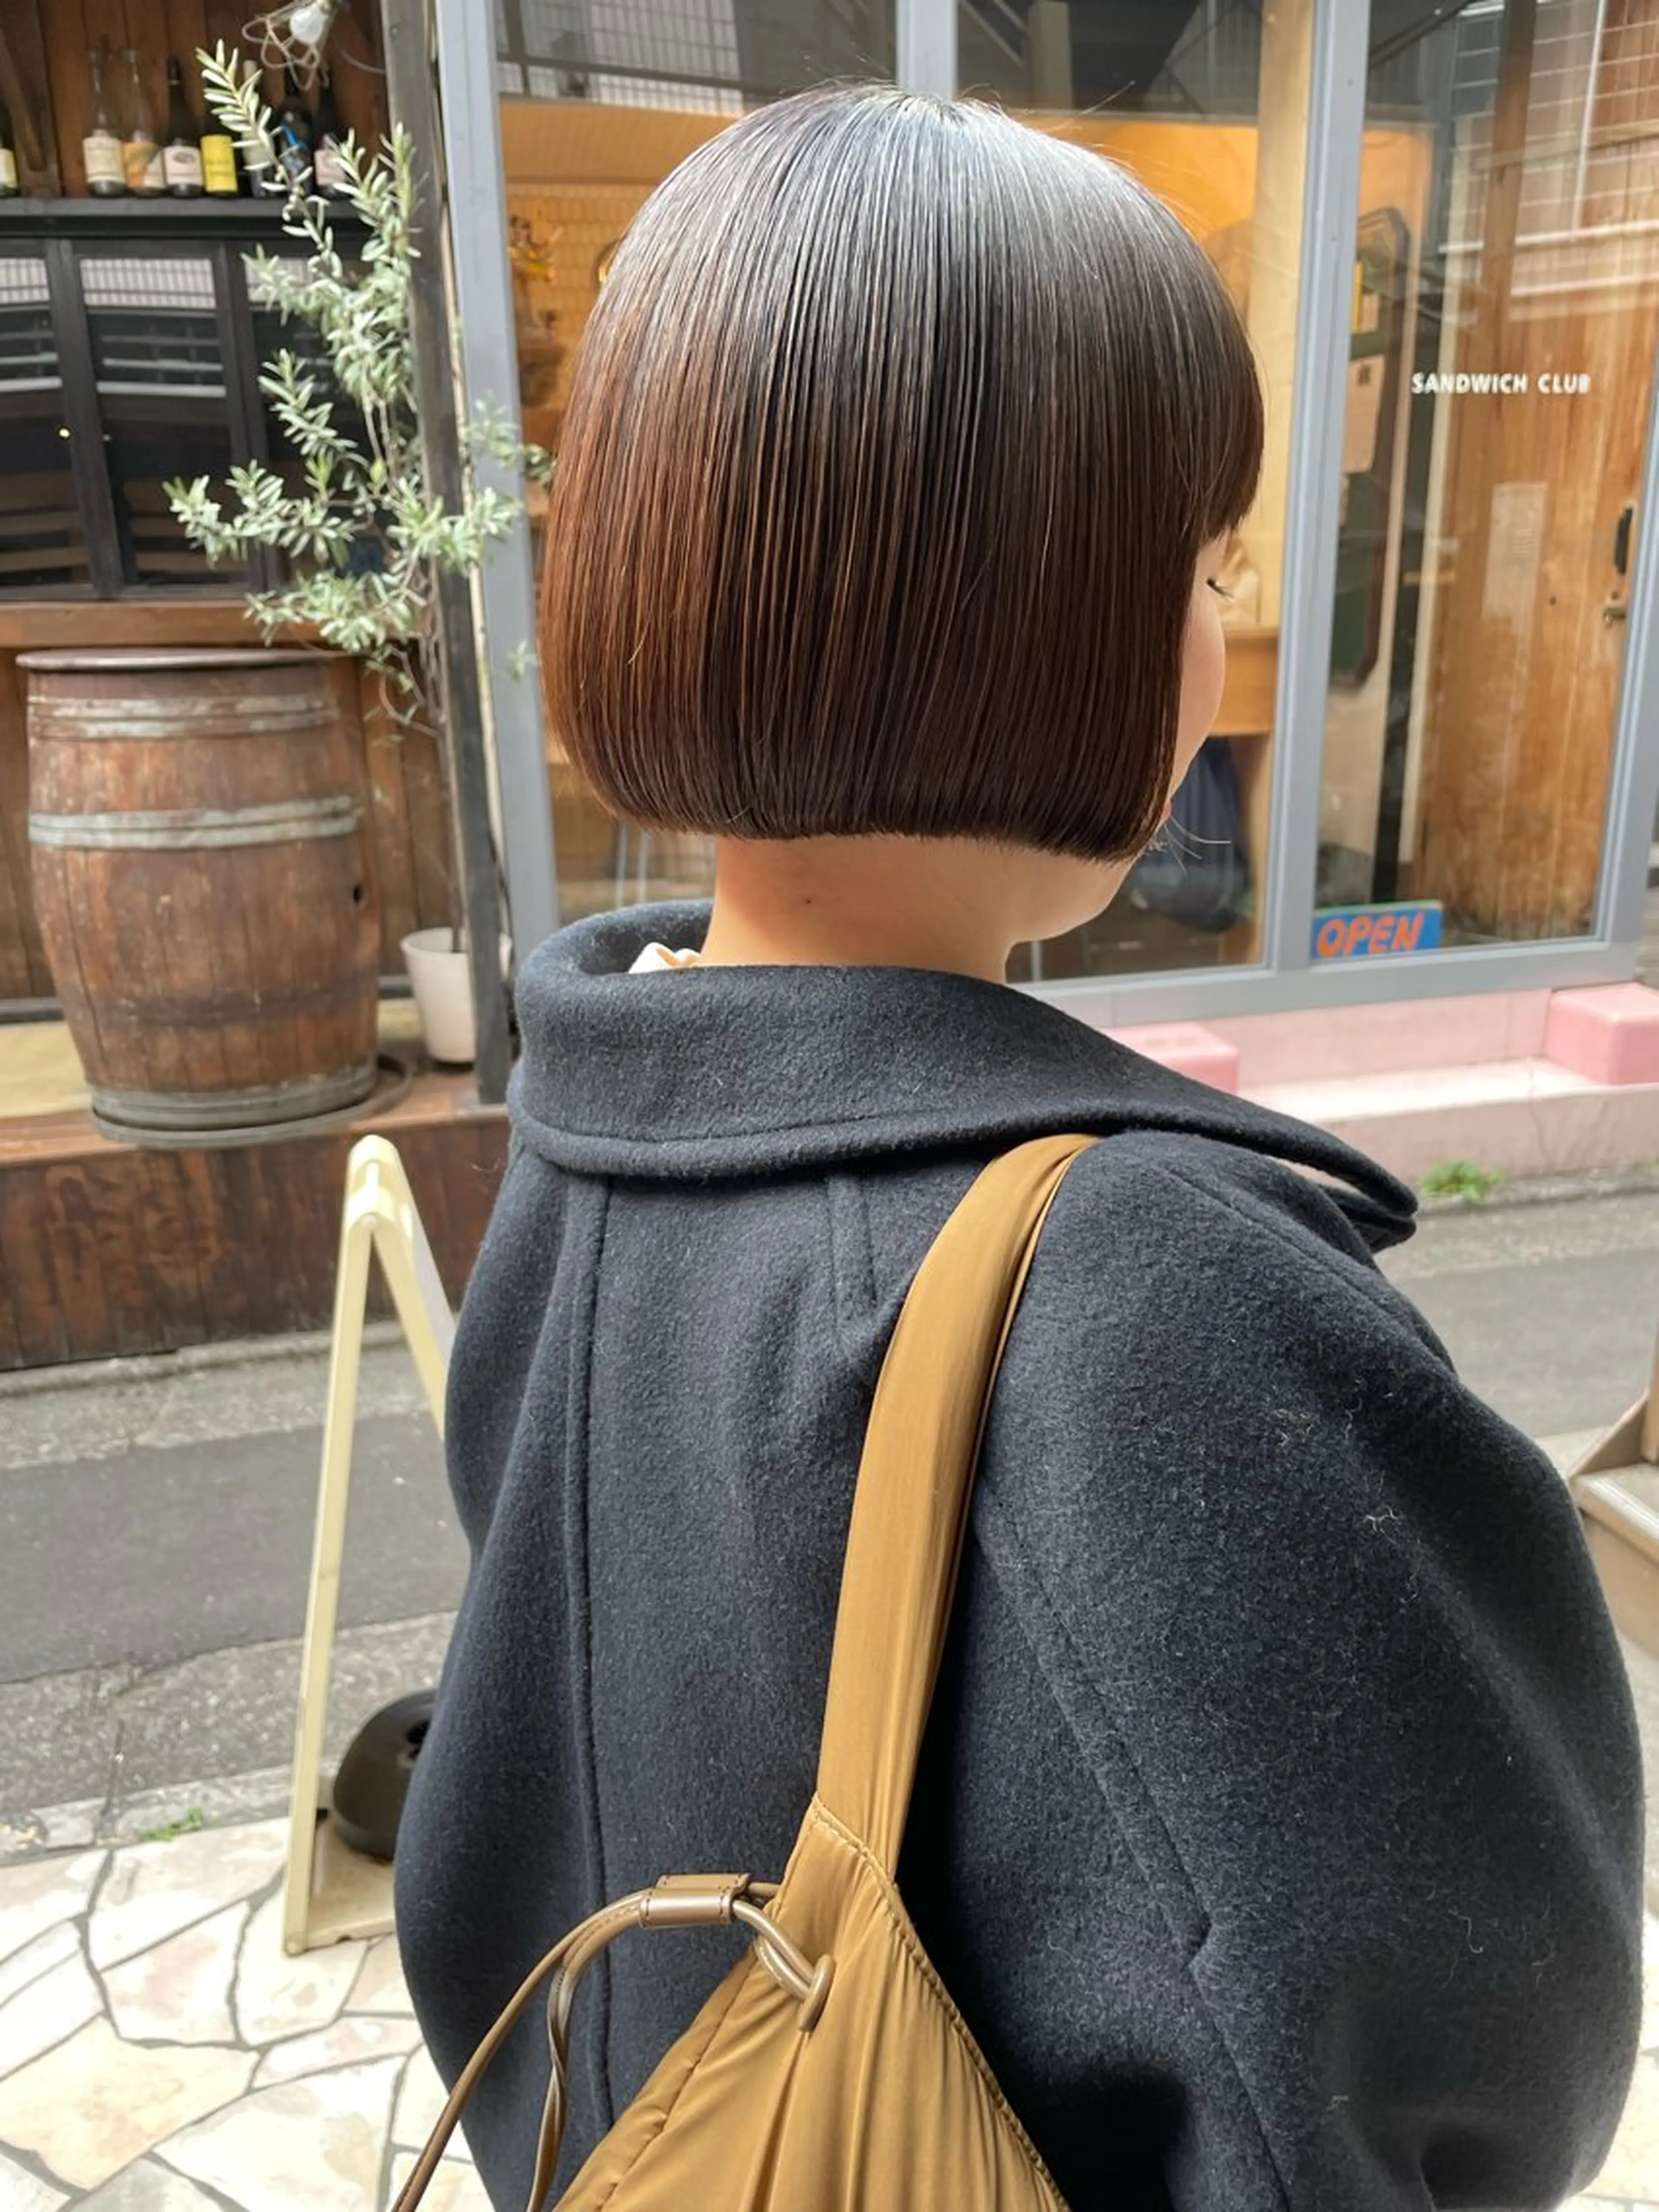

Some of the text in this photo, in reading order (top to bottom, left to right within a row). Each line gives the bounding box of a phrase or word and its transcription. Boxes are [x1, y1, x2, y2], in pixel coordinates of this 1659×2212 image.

[1412, 372, 1591, 394] SANDWICH CLUB
[1317, 912, 1424, 956] OPEN
